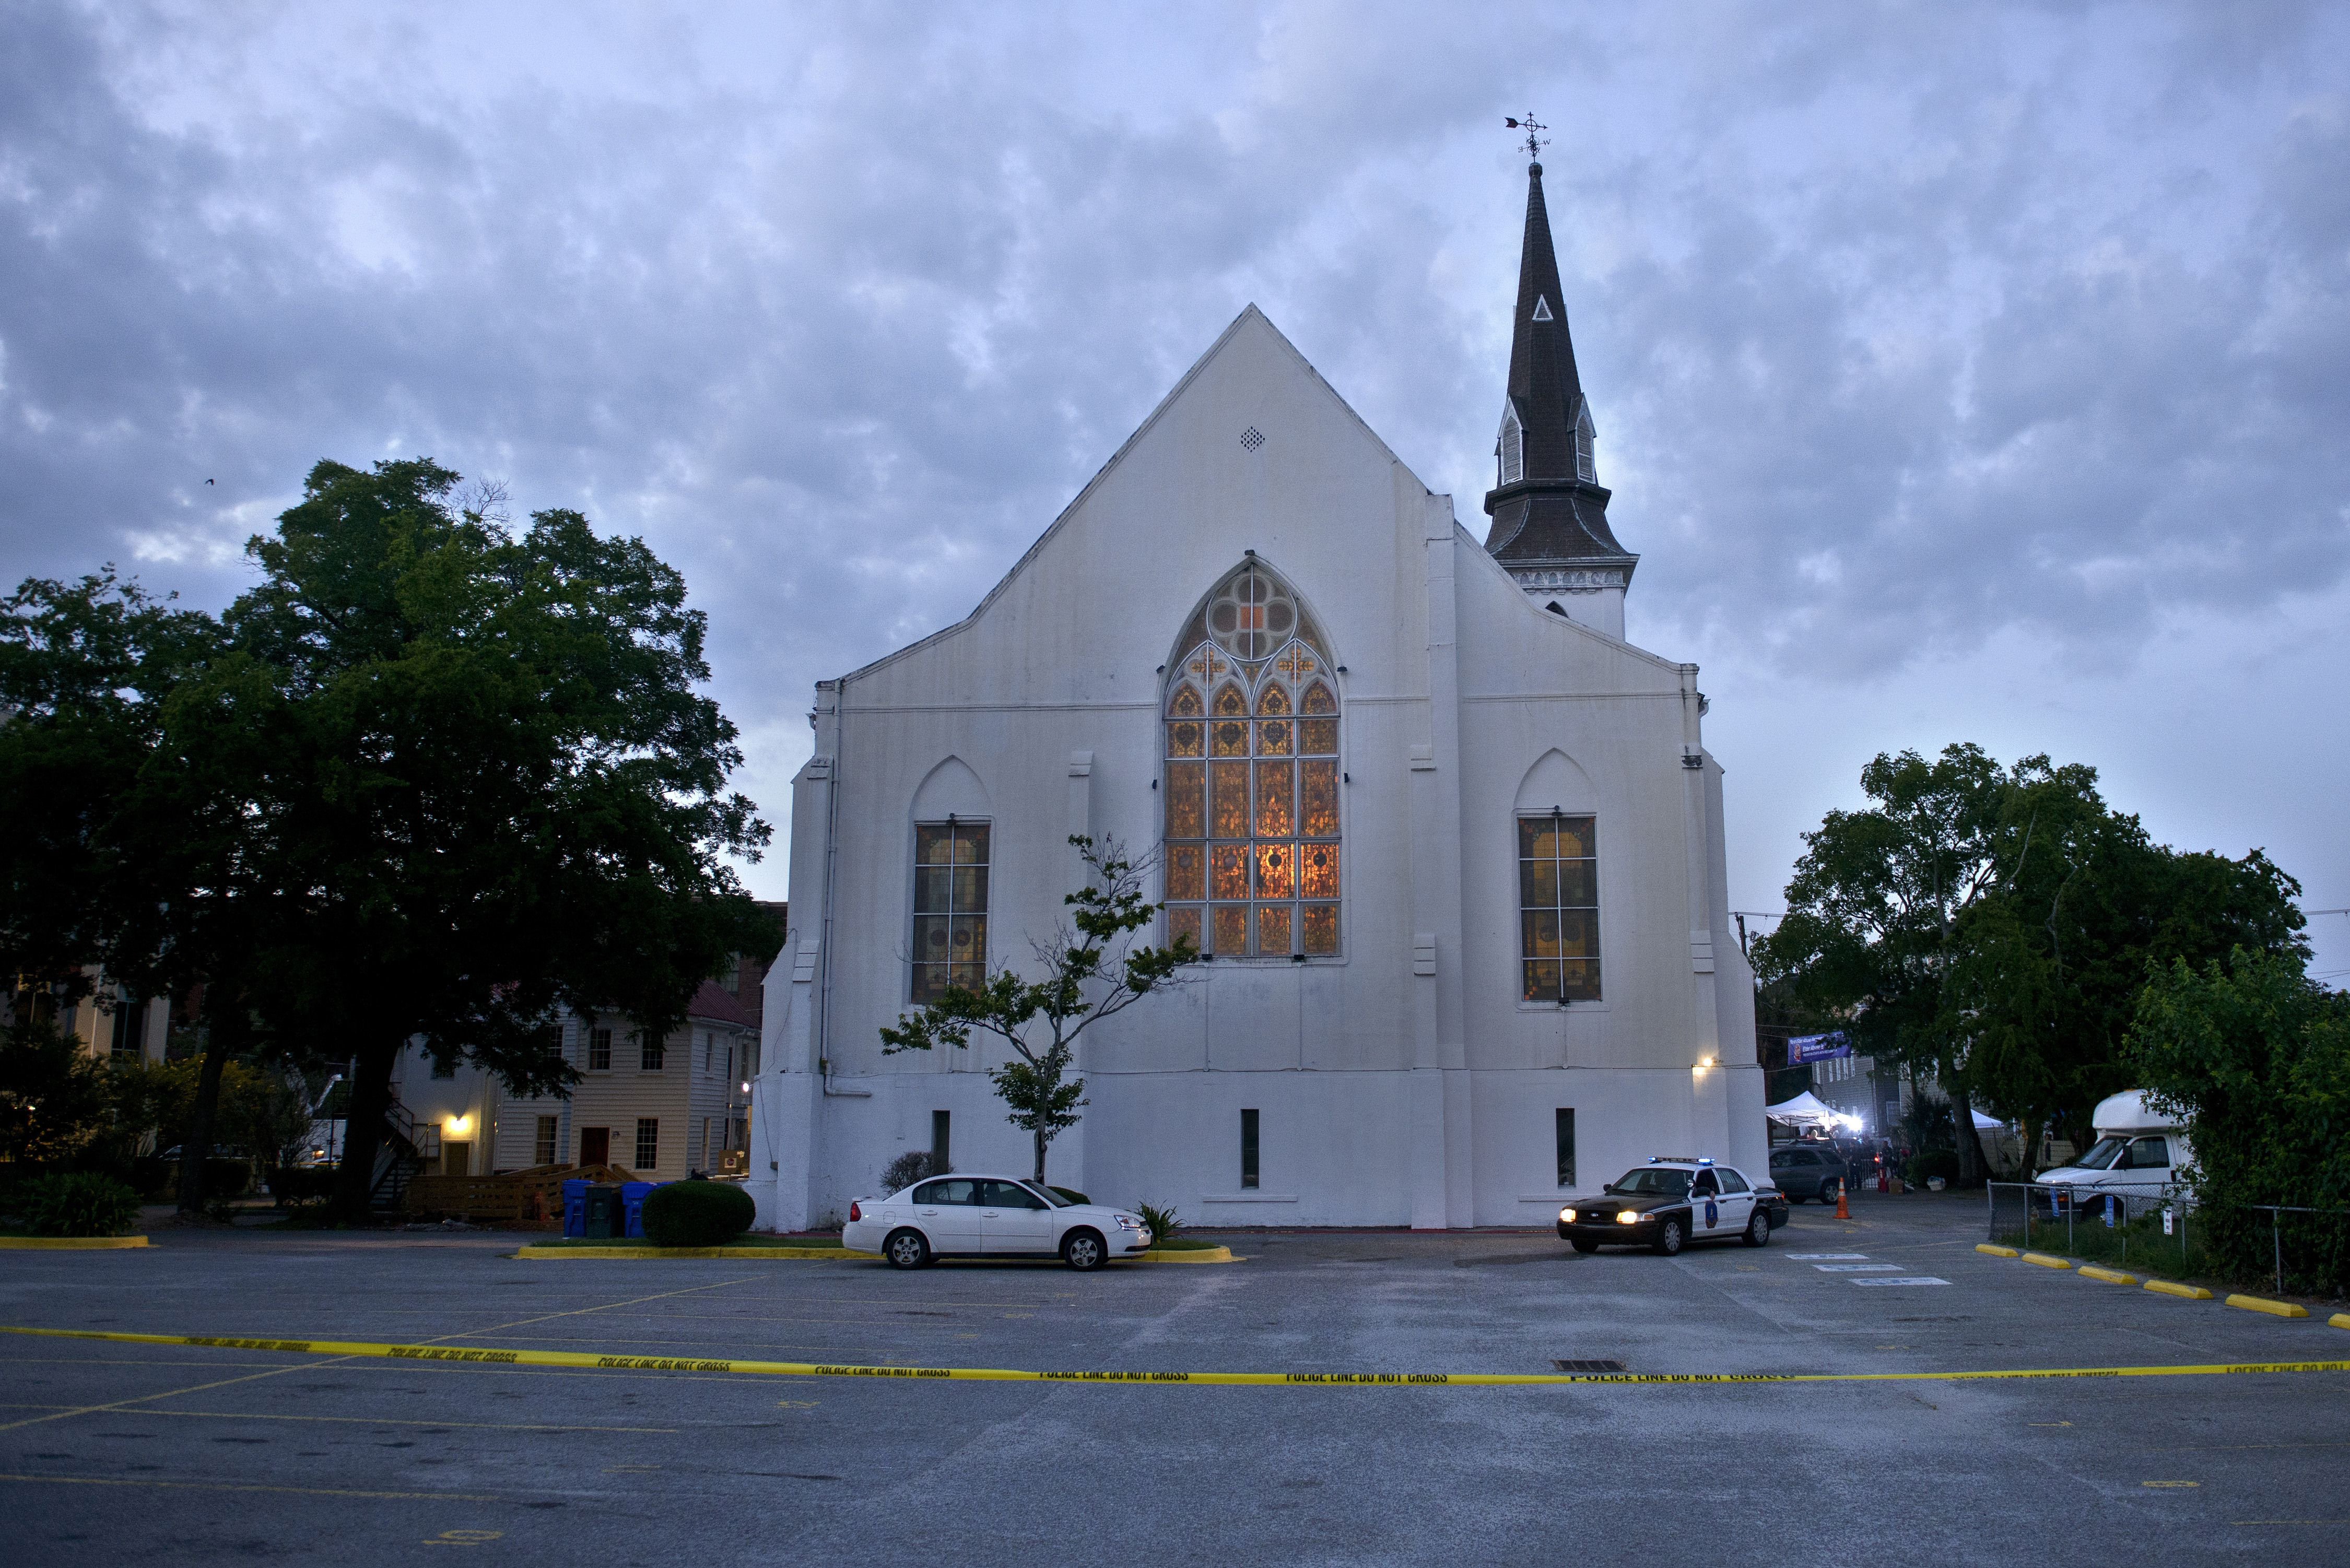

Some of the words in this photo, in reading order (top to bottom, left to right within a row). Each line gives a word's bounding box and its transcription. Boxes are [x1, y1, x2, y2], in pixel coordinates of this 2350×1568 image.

[597, 1358, 634, 1369] POLICE
[634, 1359, 659, 1370] LINE
[659, 1360, 673, 1370] DO
[674, 1361, 696, 1371] NOT
[697, 1361, 731, 1372] CROSS
[1286, 1374, 1326, 1382] POLICE
[1330, 1374, 1356, 1382] LINE
